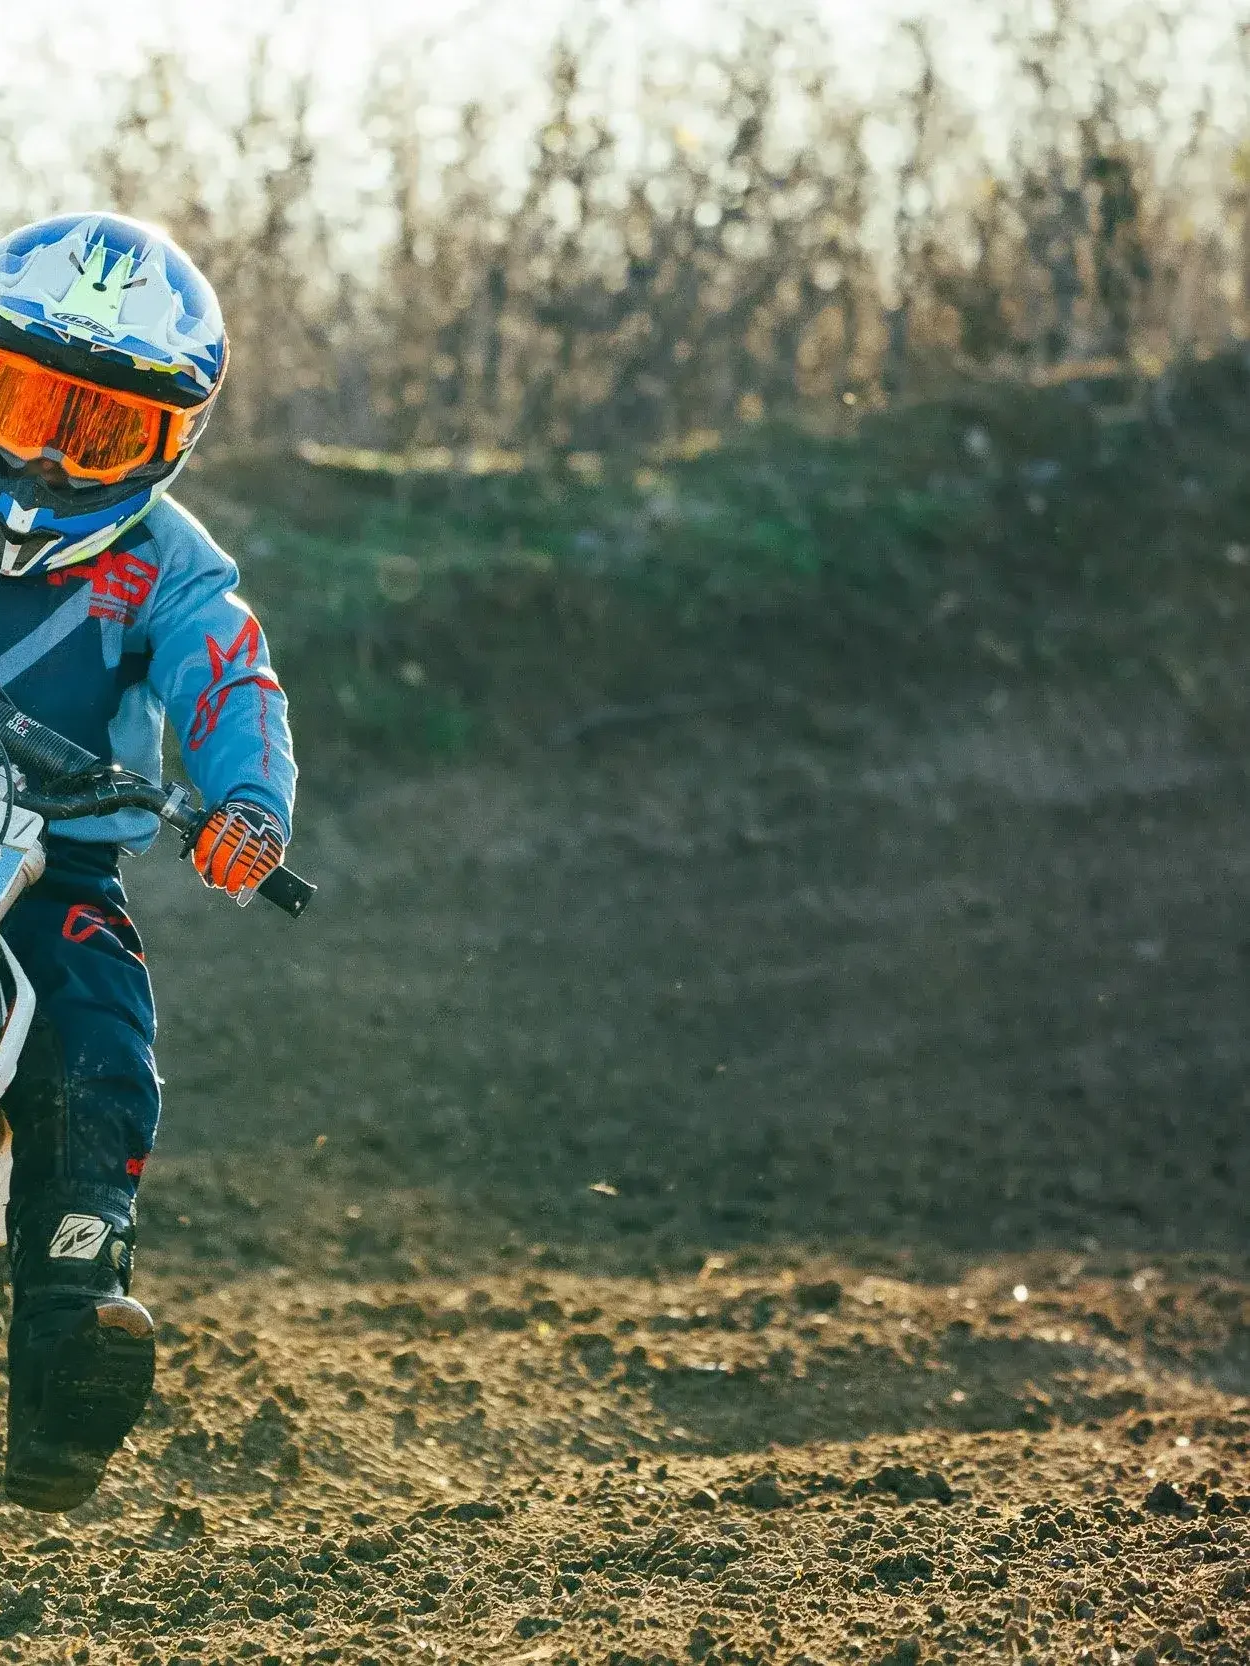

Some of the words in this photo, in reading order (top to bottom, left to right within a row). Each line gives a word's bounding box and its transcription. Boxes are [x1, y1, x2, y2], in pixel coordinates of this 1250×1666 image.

[59, 314, 106, 335] HJC
[6, 719, 29, 737] RACE
[12, 714, 24, 725] TO
[14, 711, 41, 728] READY
